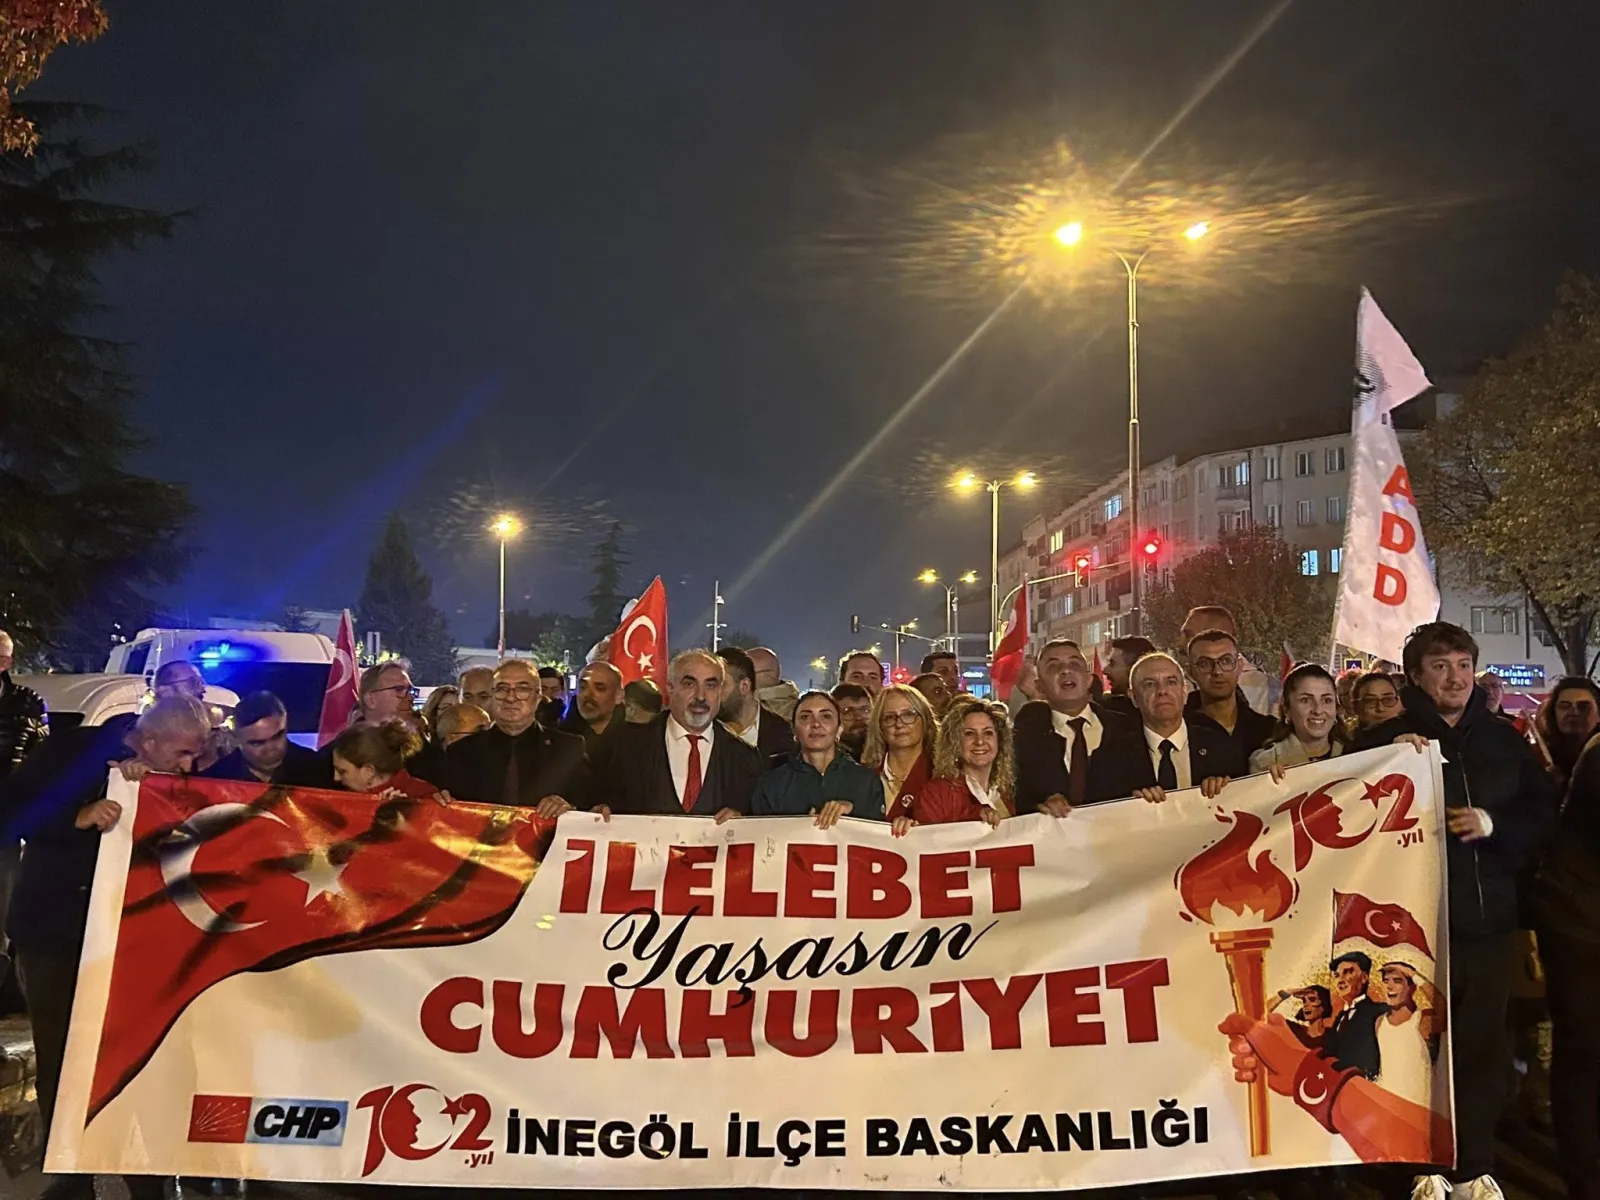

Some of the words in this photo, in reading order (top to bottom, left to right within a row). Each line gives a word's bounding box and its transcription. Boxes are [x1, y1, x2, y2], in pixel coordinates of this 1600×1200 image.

[1373, 464, 1416, 606] ADD
[603, 905, 999, 1008] Yaşasın
[253, 1105, 342, 1139] CHP
[506, 1109, 709, 1160] İNEGÖL
[726, 1112, 847, 1166] İLÇE
[865, 1099, 1208, 1157] BASKANLIĞI
